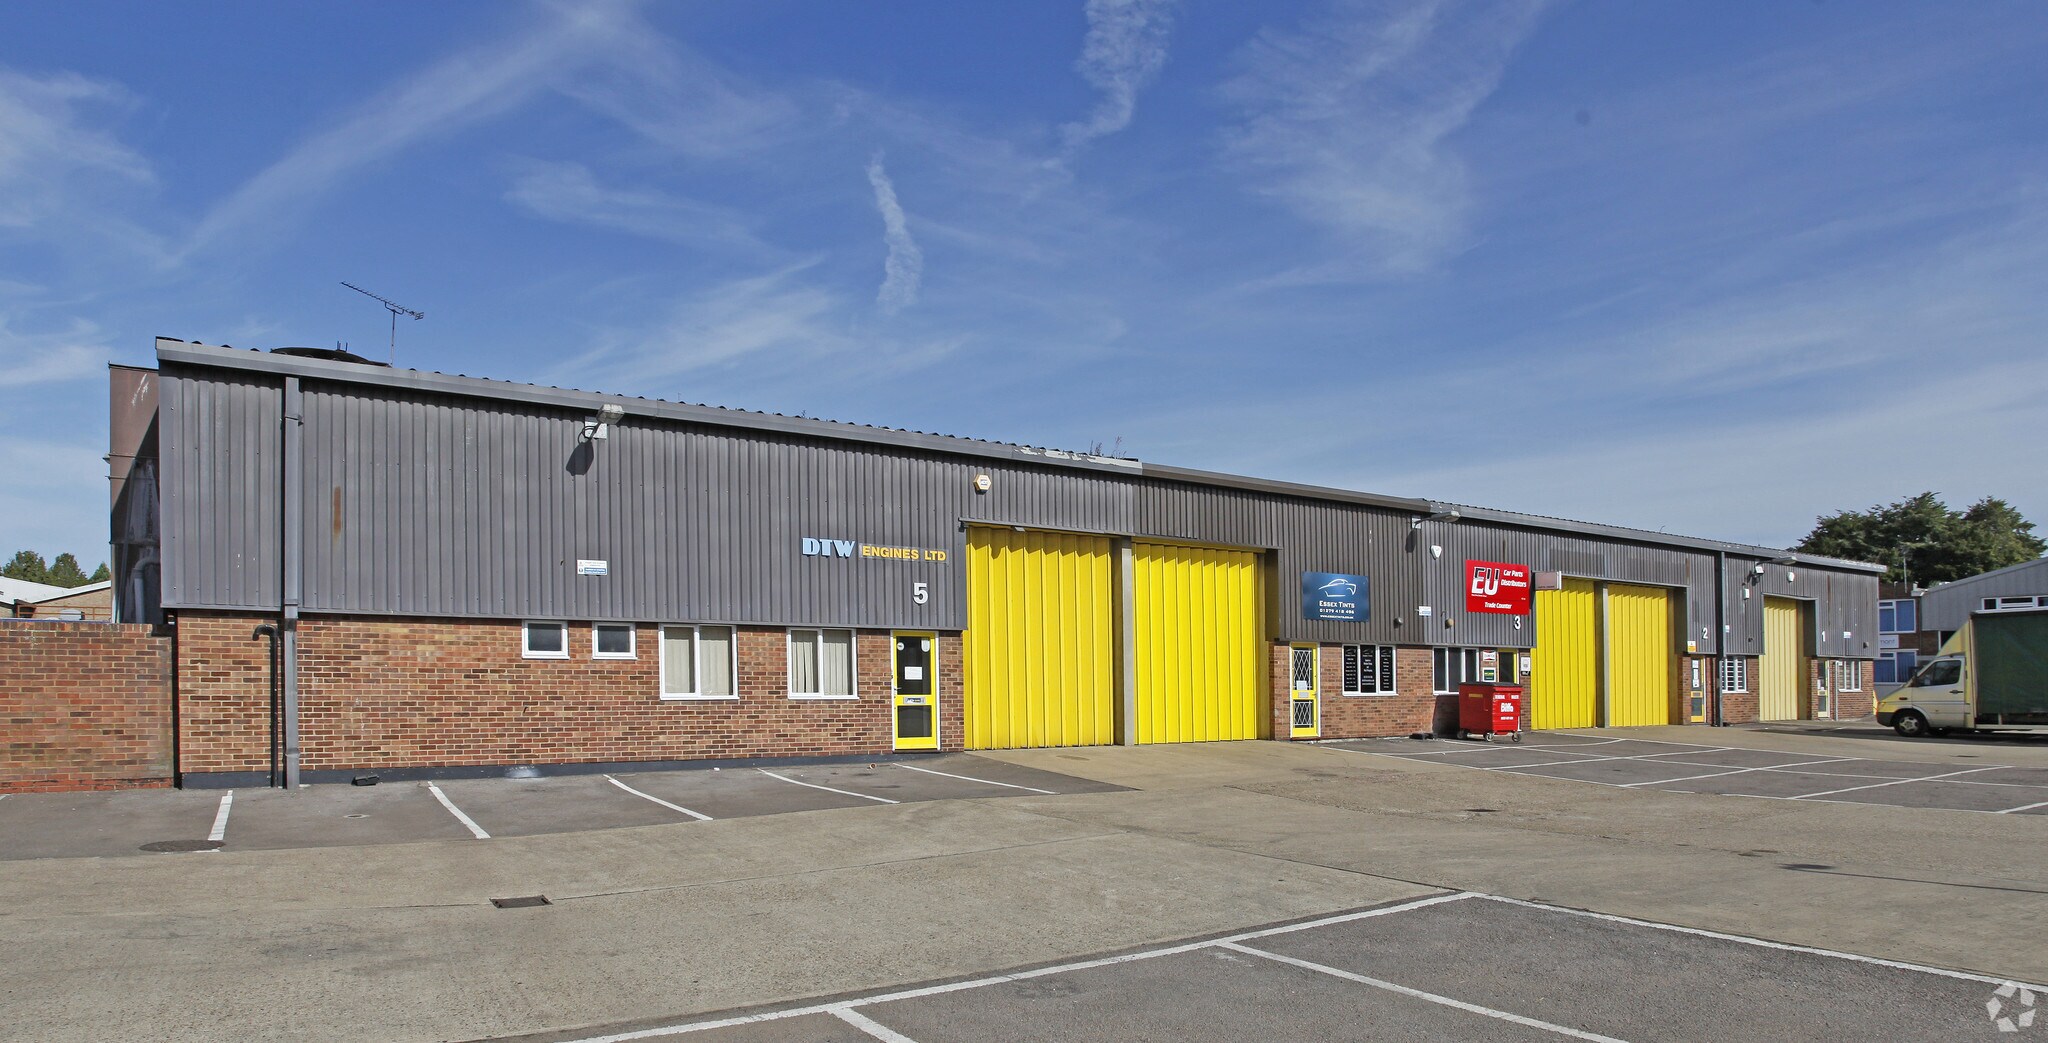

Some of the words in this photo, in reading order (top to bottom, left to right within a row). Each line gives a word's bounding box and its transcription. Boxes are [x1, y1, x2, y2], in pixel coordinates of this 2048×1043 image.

[802, 537, 856, 558] DTW
[862, 545, 920, 560] ENGINES
[924, 549, 947, 561] LTD
[1503, 569, 1512, 577] Car
[1512, 570, 1524, 578] Parts
[1471, 566, 1500, 596] EU
[1500, 578, 1527, 588] Distributors
[913, 582, 929, 605] 5
[1319, 600, 1338, 608] ESSEX
[1338, 601, 1355, 609] TINTS
[1484, 601, 1496, 609] Trade
[1496, 602, 1513, 610] Counter
[1513, 615, 1521, 630] 3
[1702, 627, 1709, 639] 2
[1821, 630, 1826, 642] 1
